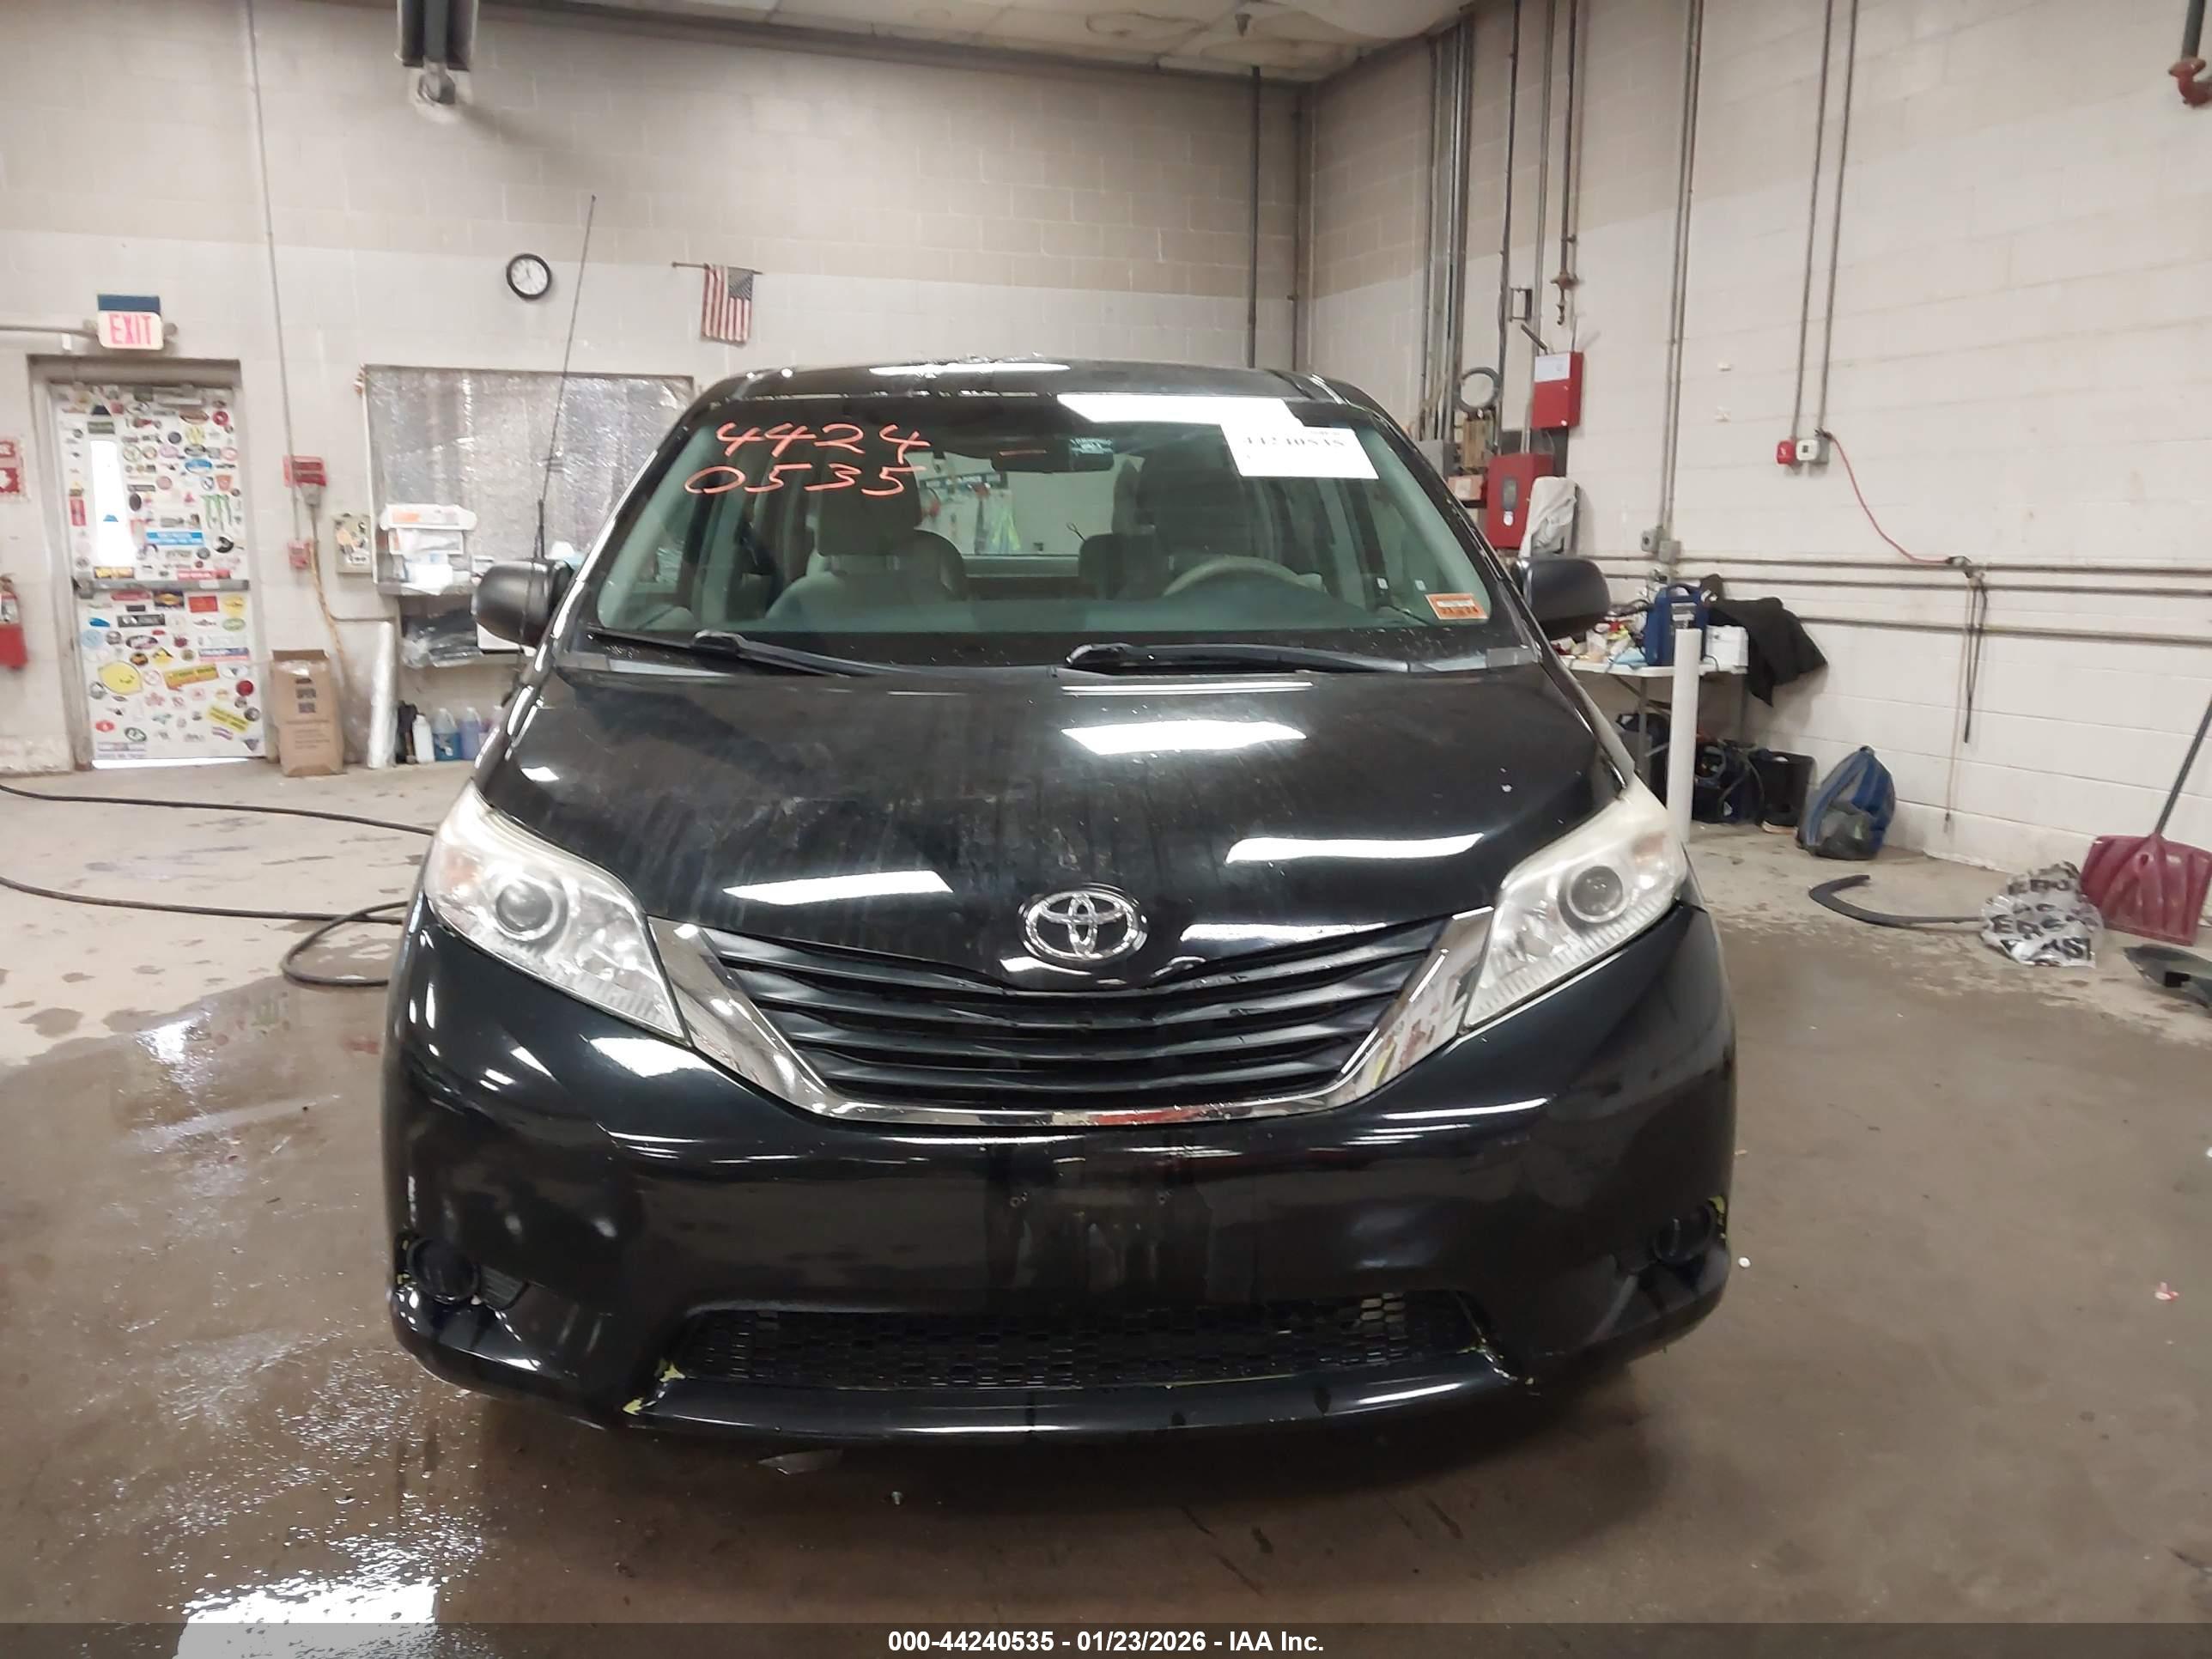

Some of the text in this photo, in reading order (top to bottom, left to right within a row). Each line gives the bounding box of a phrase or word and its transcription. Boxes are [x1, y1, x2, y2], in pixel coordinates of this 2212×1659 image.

[109, 313, 152, 345] EXIT
[715, 422, 932, 465] 4424
[684, 463, 927, 496] 0535
